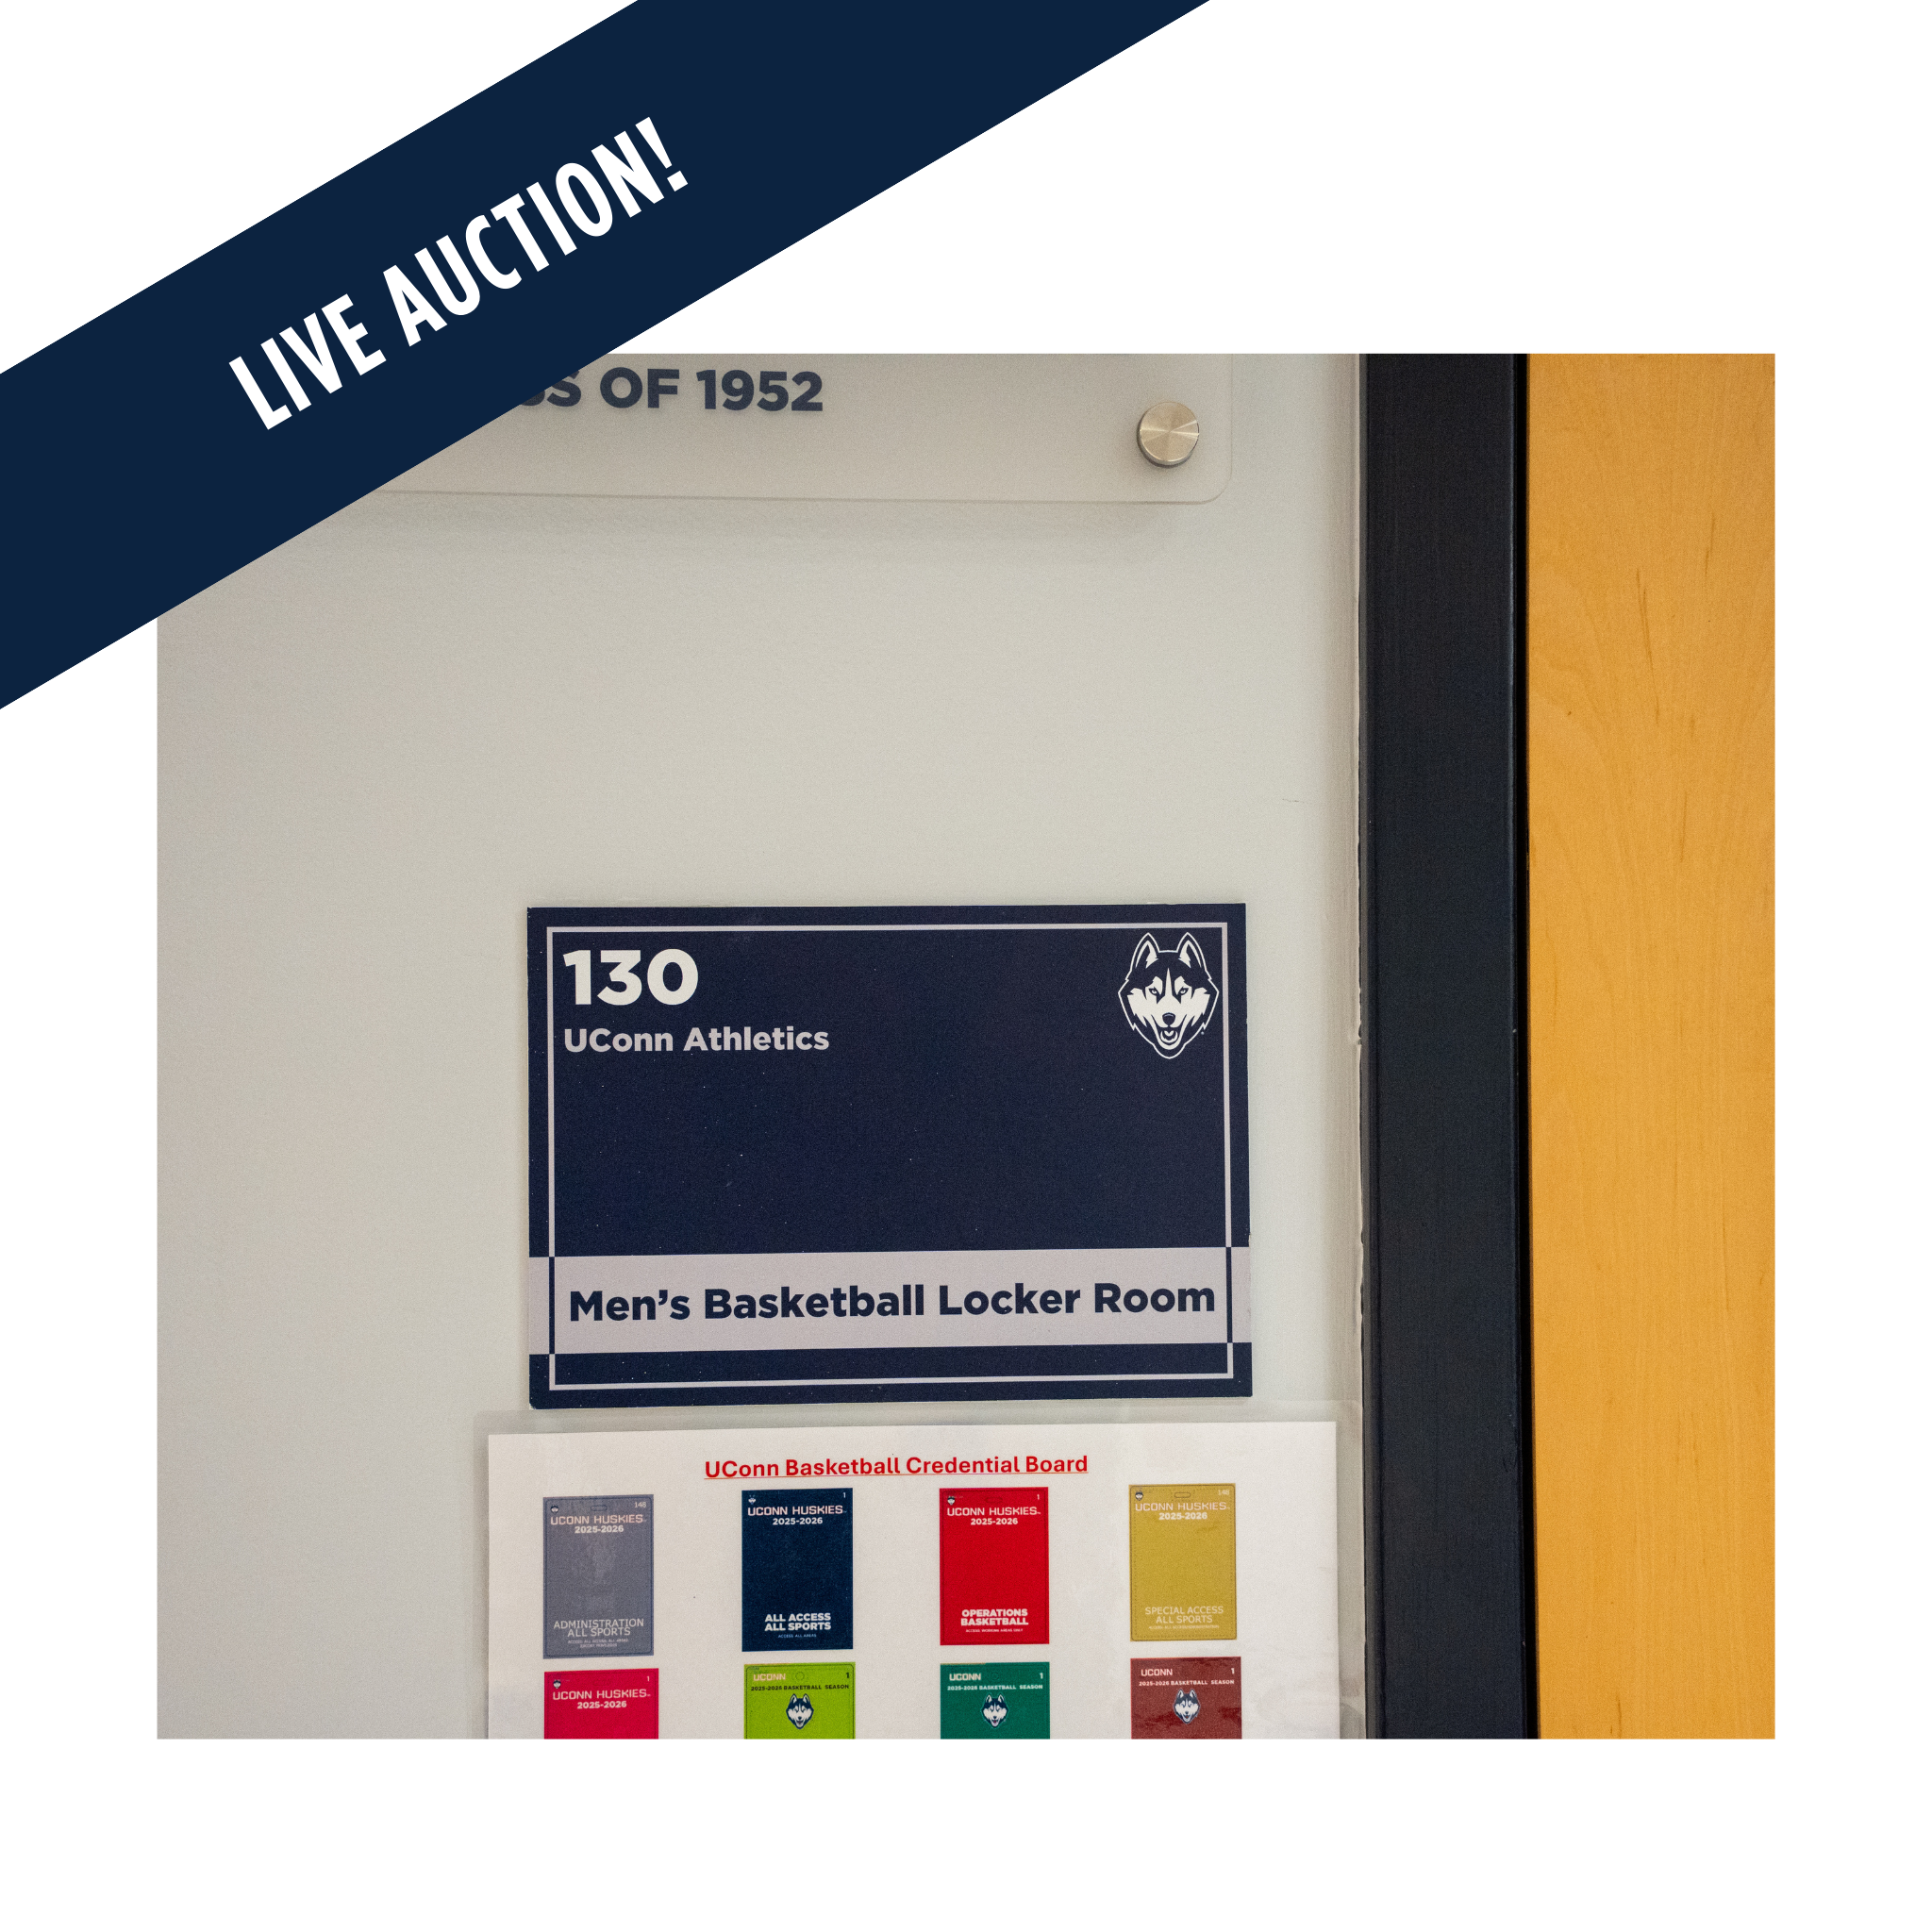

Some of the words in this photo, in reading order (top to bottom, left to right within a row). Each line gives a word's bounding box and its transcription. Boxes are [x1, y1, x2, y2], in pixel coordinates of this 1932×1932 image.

[600, 366, 680, 408] OF
[696, 369, 824, 412] 1952
[563, 948, 699, 1006] 130
[563, 1027, 675, 1053] UConn
[683, 1025, 830, 1052] Athletics
[569, 1289, 691, 1323] Men’s
[704, 1284, 925, 1320] Basketball
[939, 1282, 1081, 1316] Locker
[1093, 1281, 1216, 1313] Room
[705, 1459, 779, 1478] UConn
[785, 1457, 901, 1477] Basketball
[906, 1456, 1020, 1474] Credential
[1025, 1455, 1089, 1474] Board
[747, 1506, 789, 1517] UCONN
[792, 1504, 843, 1515] HUSKIES
[946, 1507, 985, 1517] UCONN
[989, 1506, 1038, 1516] HUSKIES
[1135, 1502, 1174, 1511] UCONN
[1177, 1501, 1227, 1511] HUSKIES
[550, 1515, 590, 1525] UCONN
[593, 1513, 643, 1524] HUSKIES
[773, 1517, 824, 1525] 2025-2026
[971, 1517, 1019, 1525] 2025-2026
[1158, 1511, 1208, 1521] 2025-2026
[575, 1524, 625, 1534] 2025-2026
[961, 1607, 1028, 1618] OPERATIONS
[1145, 1607, 1185, 1615] SPECIAL
[1187, 1606, 1224, 1614] ACCESS
[765, 1613, 786, 1623] ALL
[789, 1612, 831, 1622] ACCESS
[960, 1617, 1029, 1626] BASKETBALL
[1176, 1614, 1213, 1624] SPORTS
[553, 1618, 644, 1630] ADMINISTRATION
[765, 1623, 786, 1632] ALL
[788, 1621, 832, 1631] SPORTS
[568, 1628, 588, 1638] ALL
[591, 1626, 631, 1638] SPORTS
[949, 1673, 982, 1681] UCONN
[1141, 1668, 1174, 1676] UCONN
[553, 1690, 592, 1700] UCONN
[596, 1689, 647, 1699] HUSKIES
[576, 1701, 627, 1709] 2025-2026
